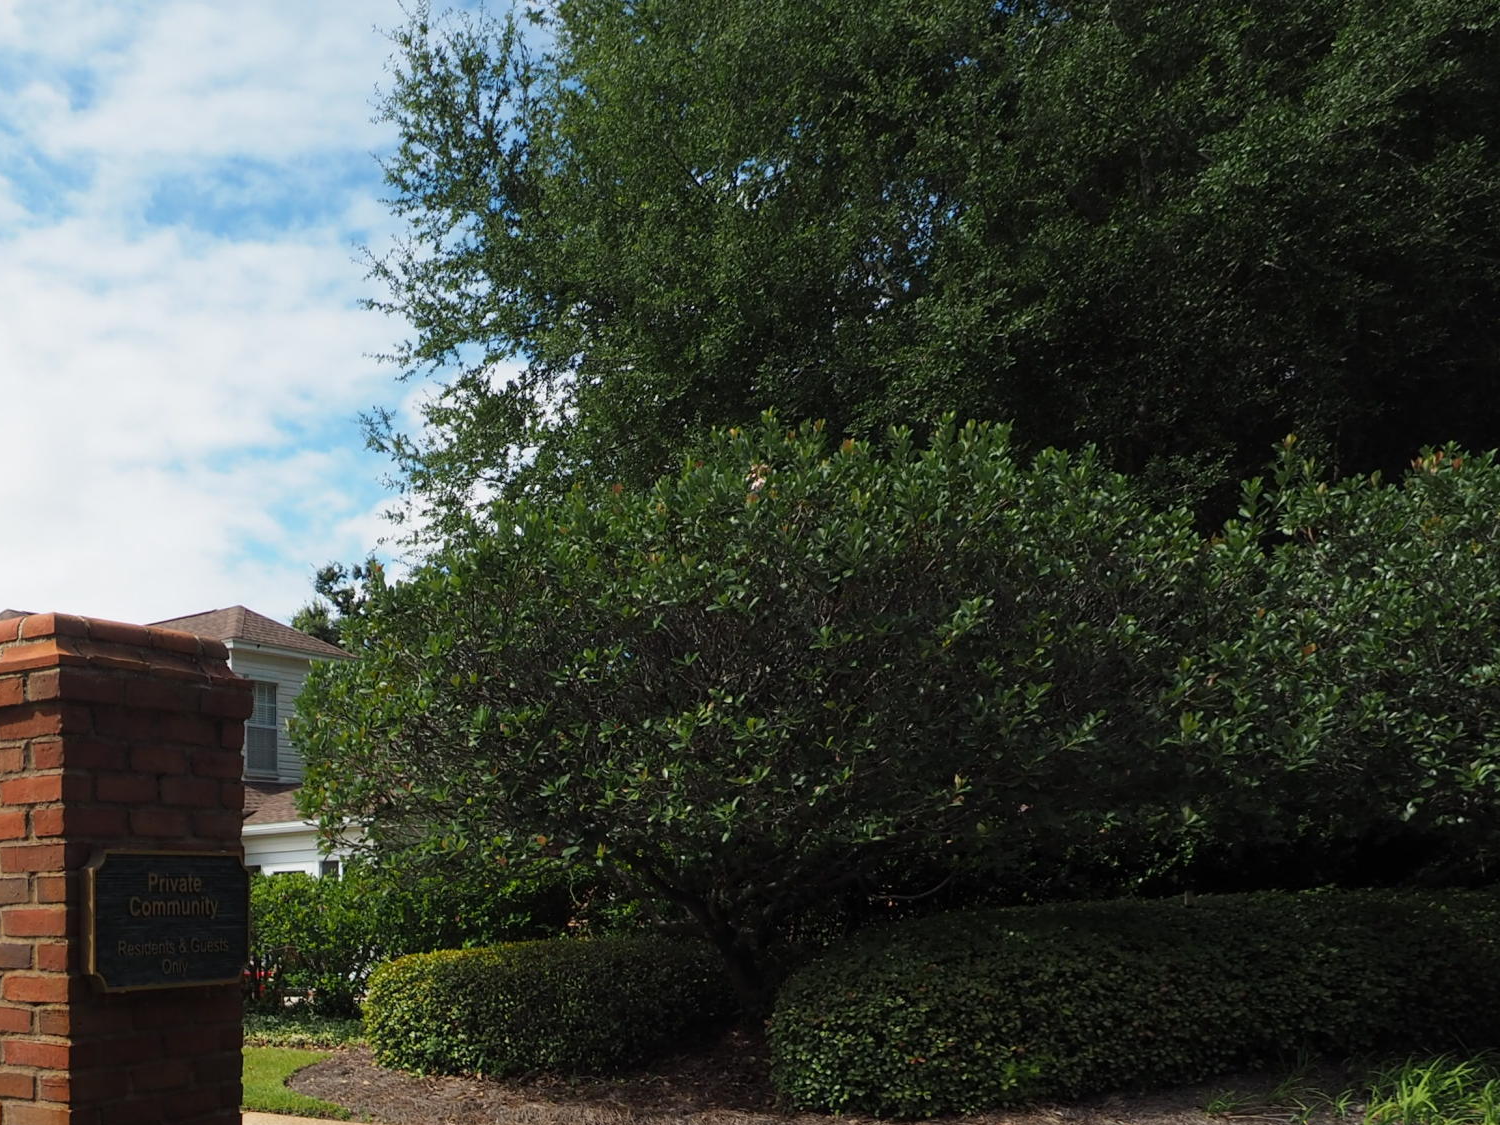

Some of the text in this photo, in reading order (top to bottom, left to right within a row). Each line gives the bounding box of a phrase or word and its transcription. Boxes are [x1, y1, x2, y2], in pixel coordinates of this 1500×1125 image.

[148, 872, 202, 893] Private
[129, 896, 219, 919] Community
[117, 937, 229, 956] Residents & Guests
[162, 958, 189, 976] Only
